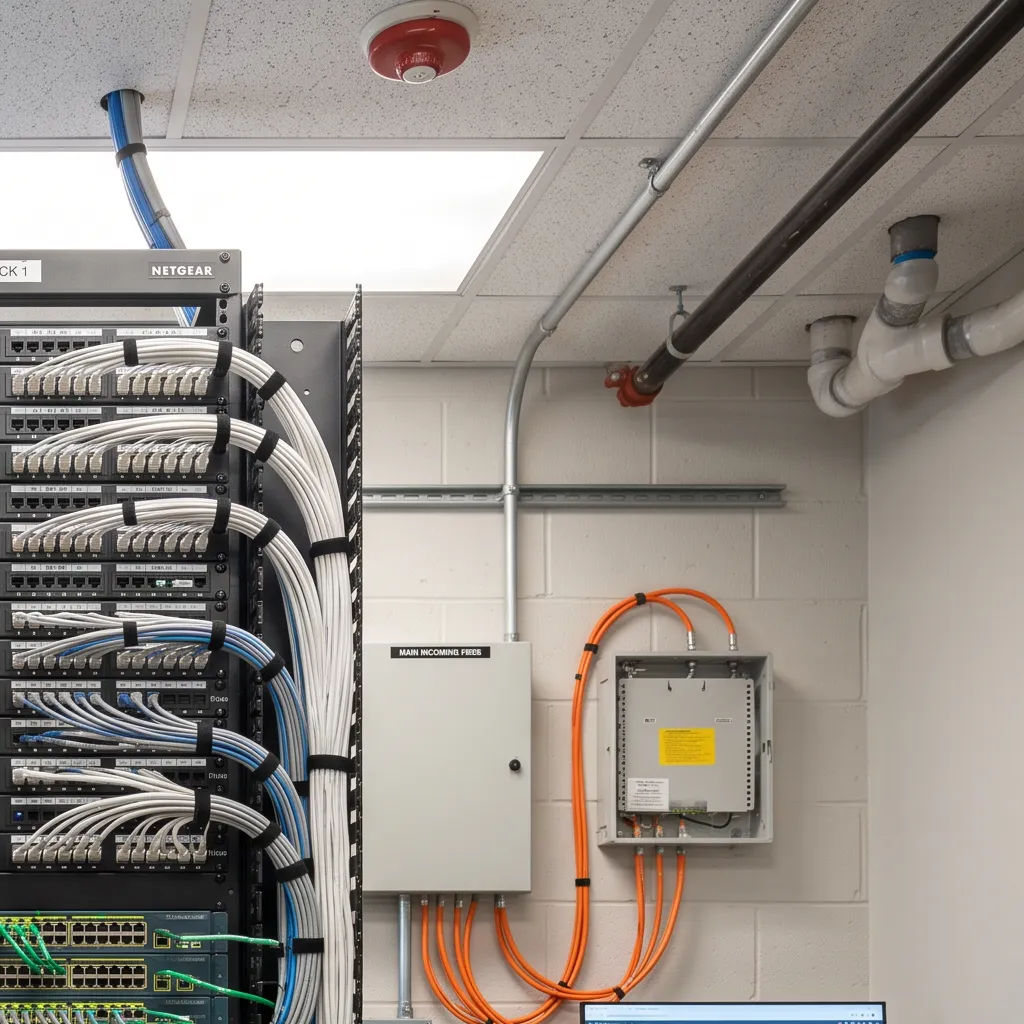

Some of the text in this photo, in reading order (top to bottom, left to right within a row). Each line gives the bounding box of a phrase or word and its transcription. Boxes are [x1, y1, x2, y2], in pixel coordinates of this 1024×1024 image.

[21, 266, 28, 277] 1
[151, 266, 213, 277] NETGEAR
[399, 648, 419, 656] MAIN
[420, 648, 460, 656] INCOMING
